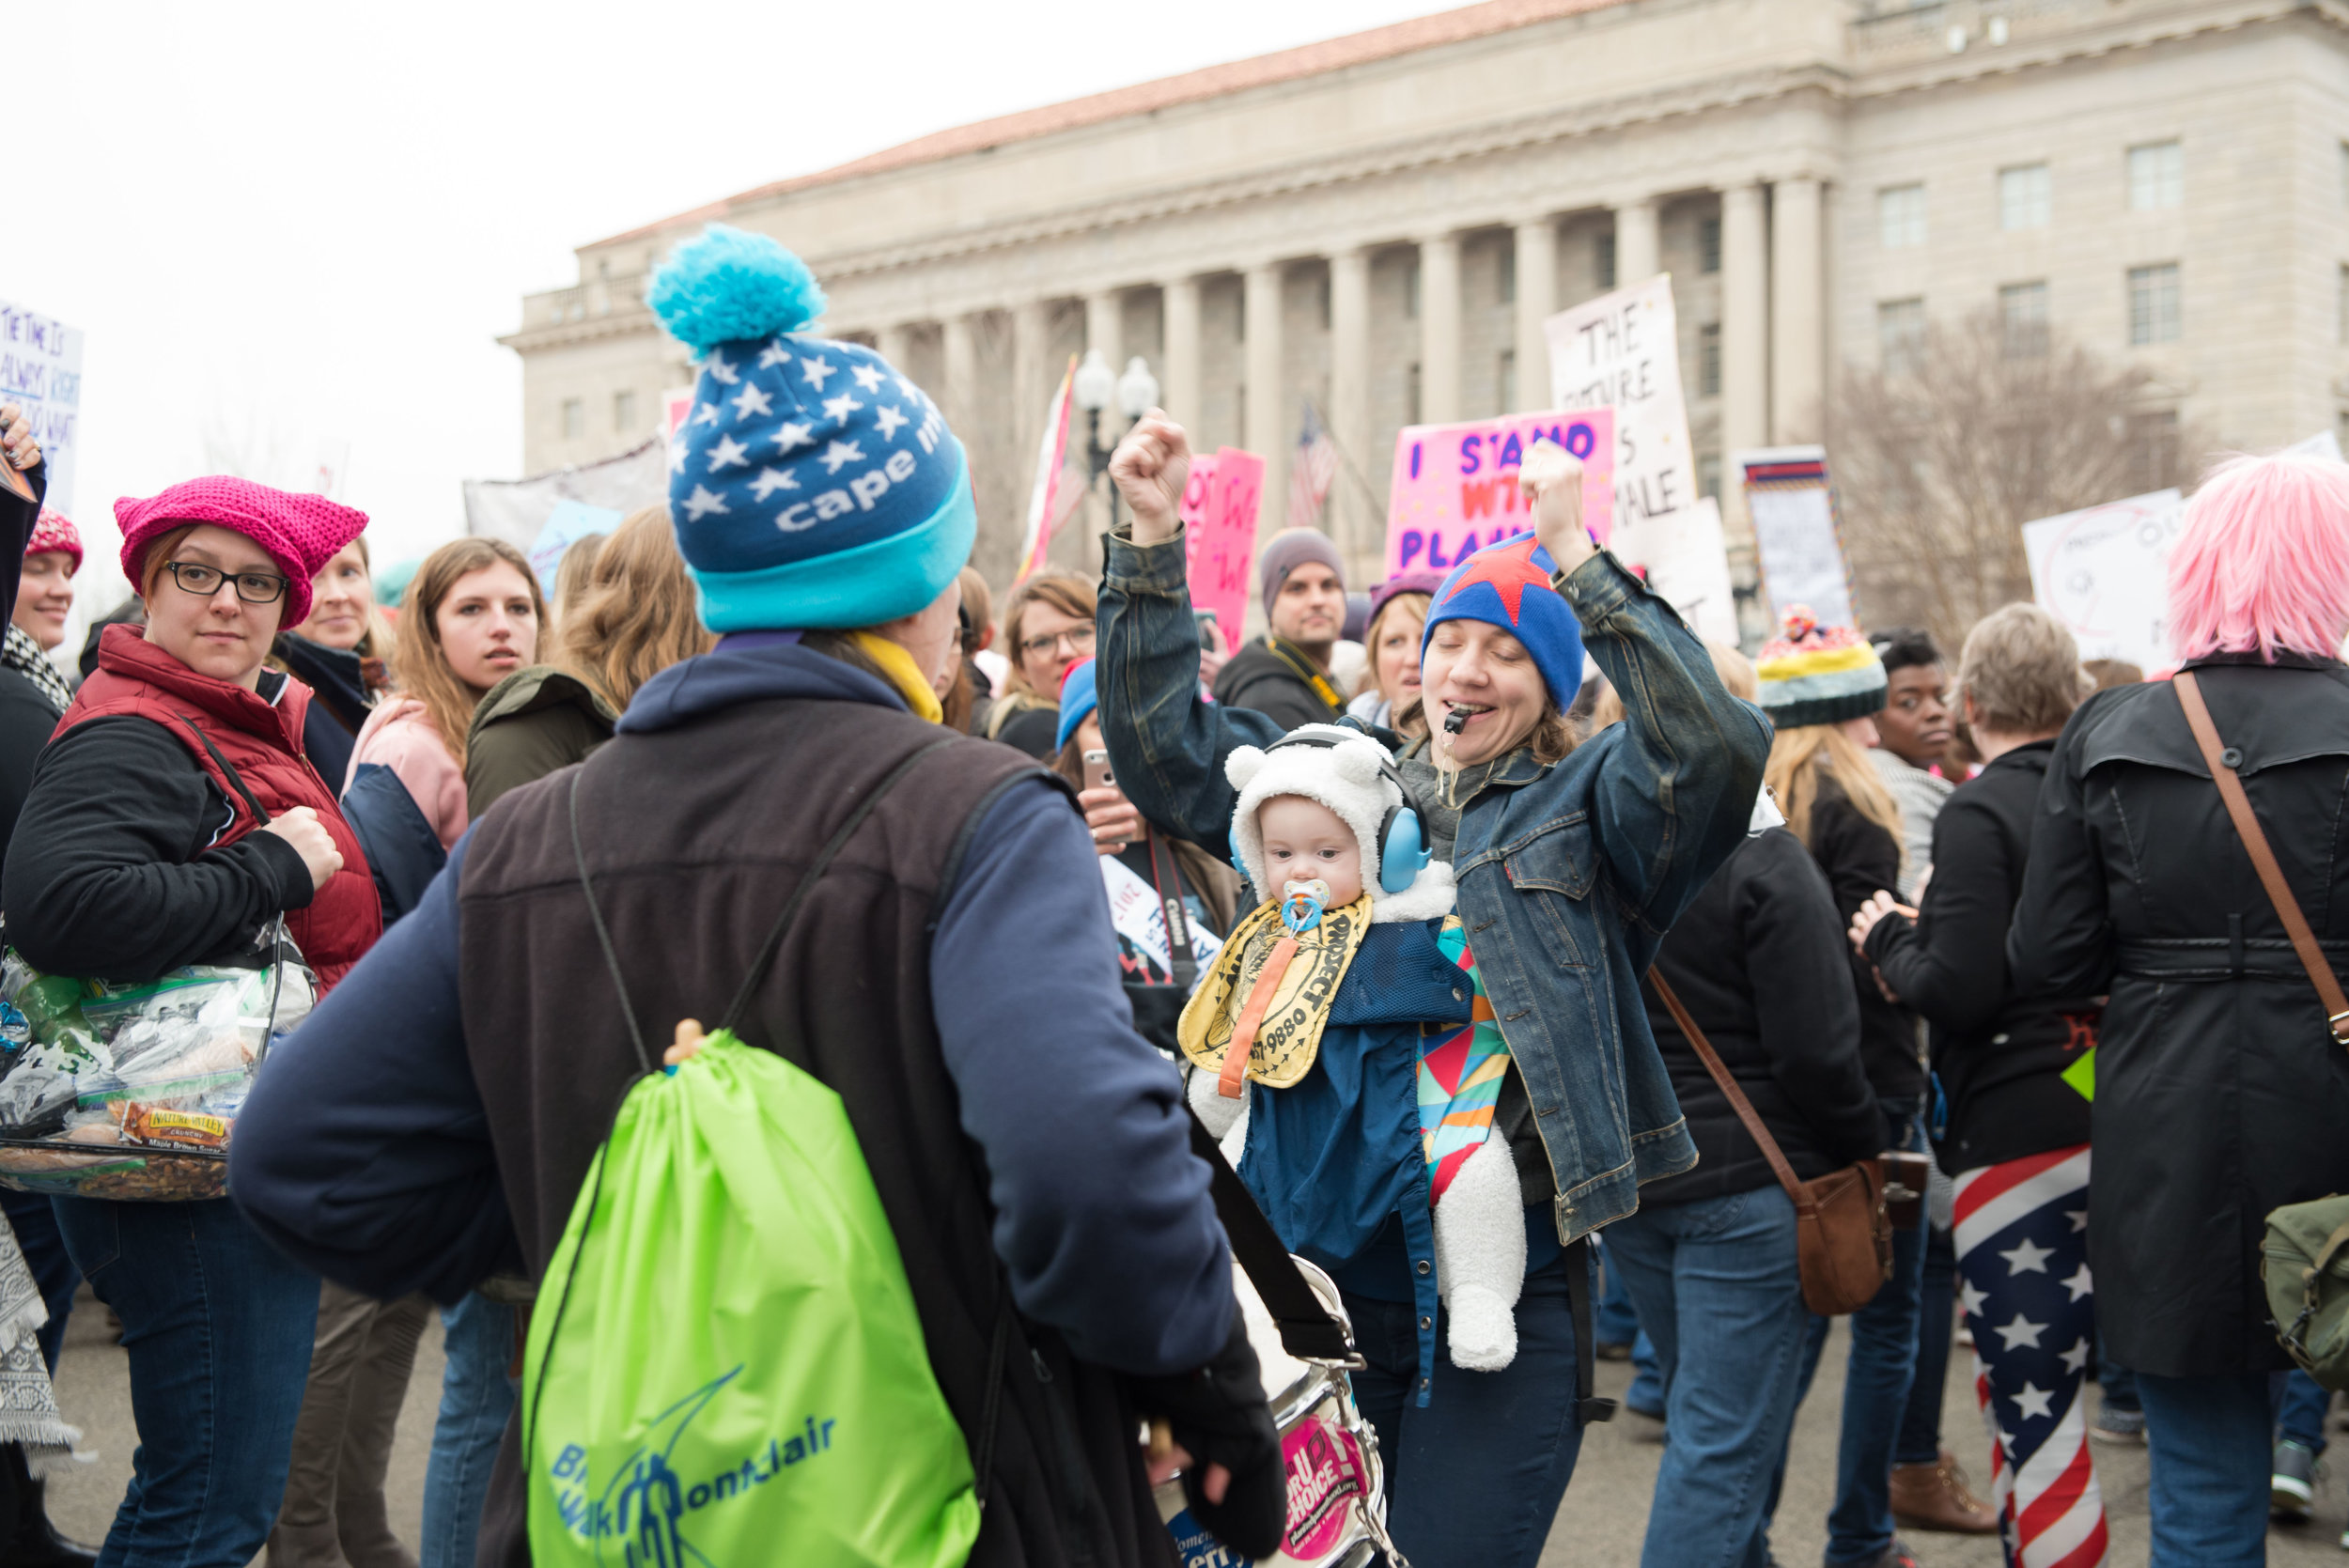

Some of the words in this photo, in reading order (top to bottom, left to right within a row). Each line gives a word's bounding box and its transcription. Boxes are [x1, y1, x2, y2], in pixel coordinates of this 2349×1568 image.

[1579, 301, 1640, 366] THE
[1461, 424, 1595, 474] SAD
[774, 449, 917, 533] cape
[1302, 914, 1351, 1012] PROJECT
[152, 1111, 189, 1126] NATURE
[192, 1116, 225, 1133] VALLEY
[170, 1129, 204, 1139] CRUNCHY
[148, 1139, 171, 1148] Maple
[173, 1141, 197, 1151] Brown
[1174, 1531, 1213, 1552] omen
